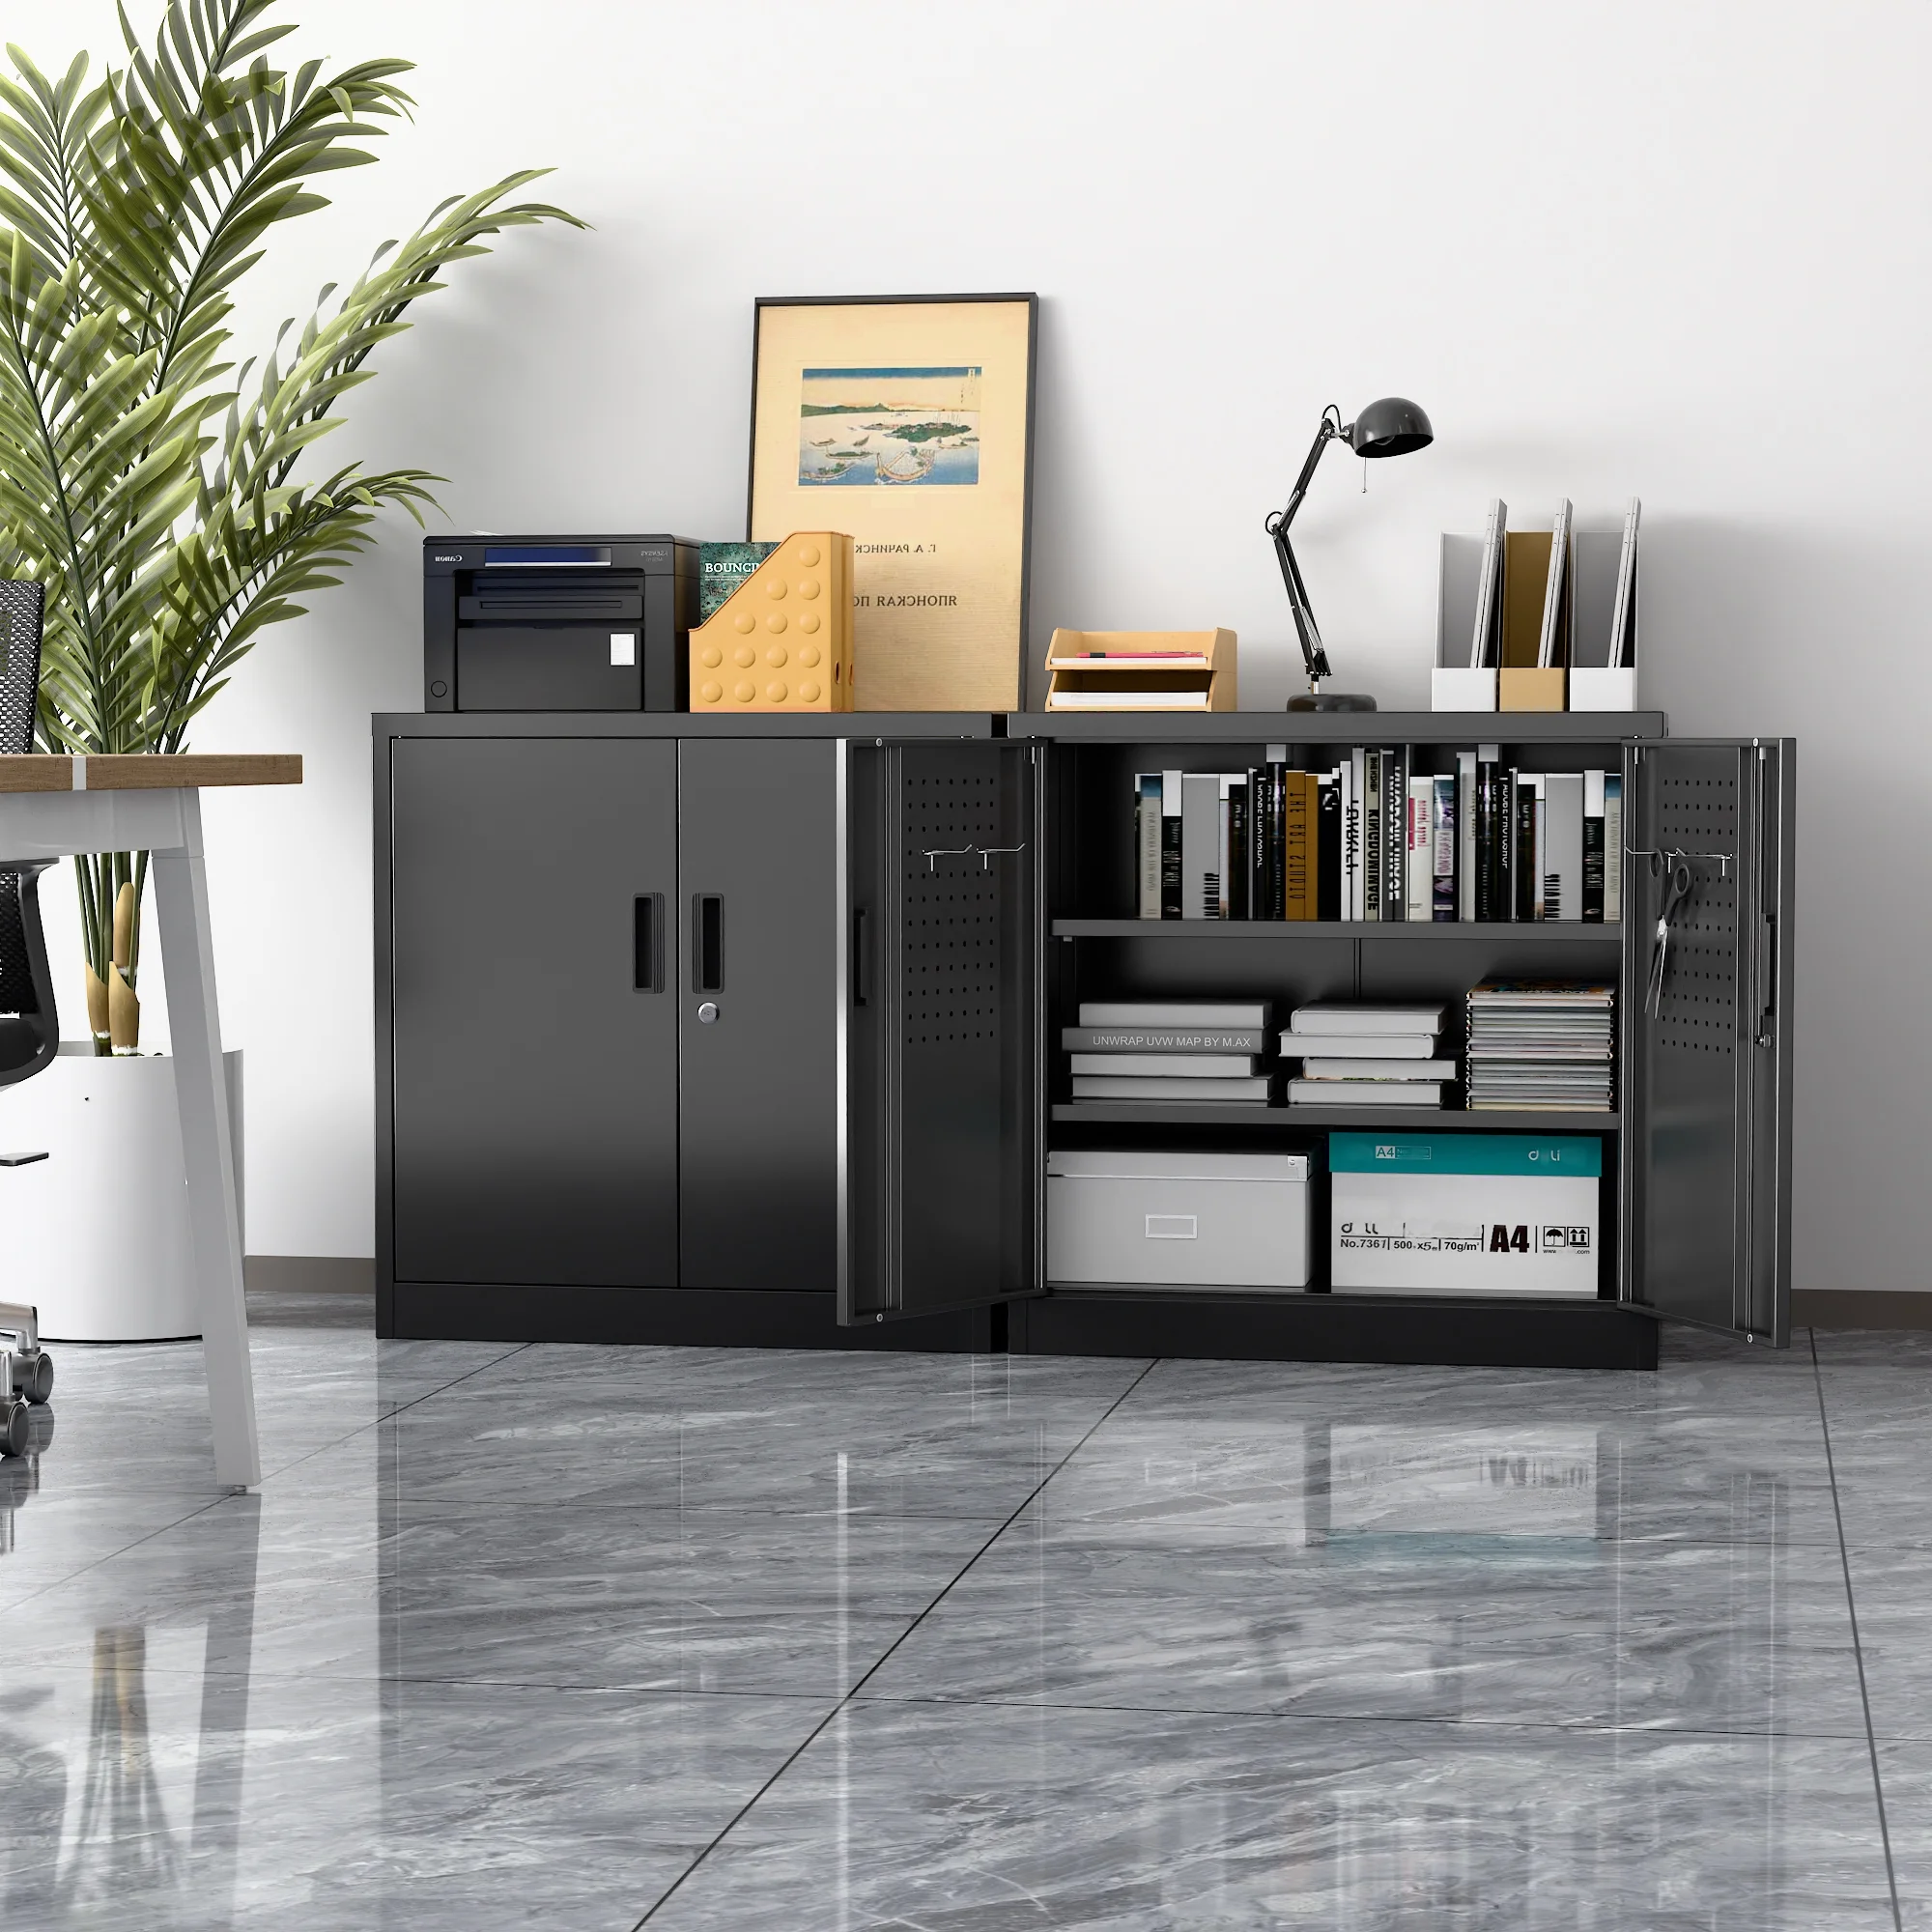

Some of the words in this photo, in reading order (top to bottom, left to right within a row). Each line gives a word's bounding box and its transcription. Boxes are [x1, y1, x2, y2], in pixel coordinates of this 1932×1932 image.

[1093, 1036, 1144, 1046] UNWRAP
[1146, 1037, 1174, 1046] UVW
[1176, 1037, 1202, 1047] MAP
[1204, 1037, 1220, 1047] BY
[1222, 1037, 1251, 1048] M.AX
[1377, 1146, 1395, 1157] A4
[1490, 1224, 1530, 1254] A4
